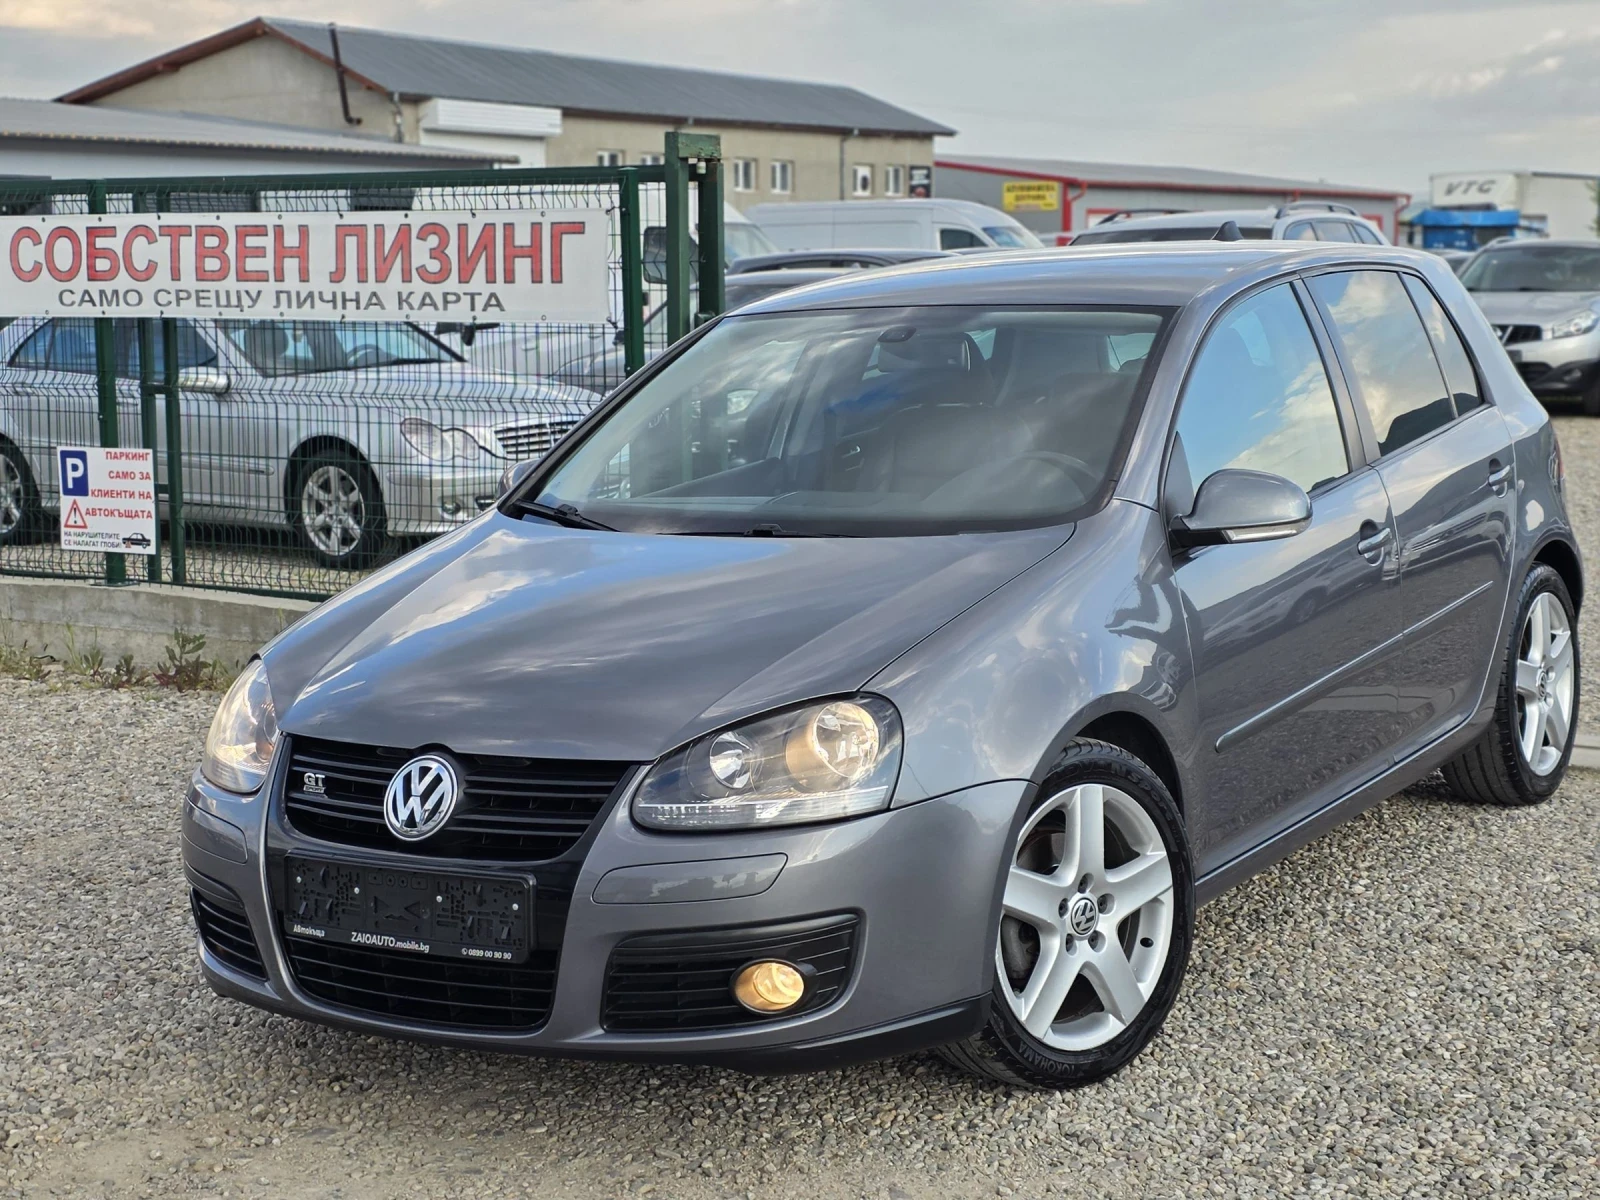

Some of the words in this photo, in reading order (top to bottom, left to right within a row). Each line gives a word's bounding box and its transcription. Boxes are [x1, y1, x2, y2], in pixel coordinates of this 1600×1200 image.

[9, 223, 310, 283] СОБСТВЕН
[329, 221, 586, 284] ЛИЗИНГ
[58, 288, 144, 308] САМО
[153, 288, 263, 312] СРЕЩУ
[272, 289, 387, 311] ЛИЧНА
[396, 290, 506, 312] КАРТА
[105, 451, 150, 461] ПАРКИНГ
[66, 457, 84, 489] P
[108, 470, 136, 480] САМО
[138, 471, 151, 481] ЗА
[90, 488, 136, 499] КЛИЕНТИ
[138, 491, 152, 500] НА
[85, 507, 153, 520] АВТОКЪЩАТА
[73, 531, 121, 540] НАРУШИТЕЛИТЕ
[303, 772, 326, 787] GT
[350, 931, 430, 953] ZAIOAUTO.mobile.bg
